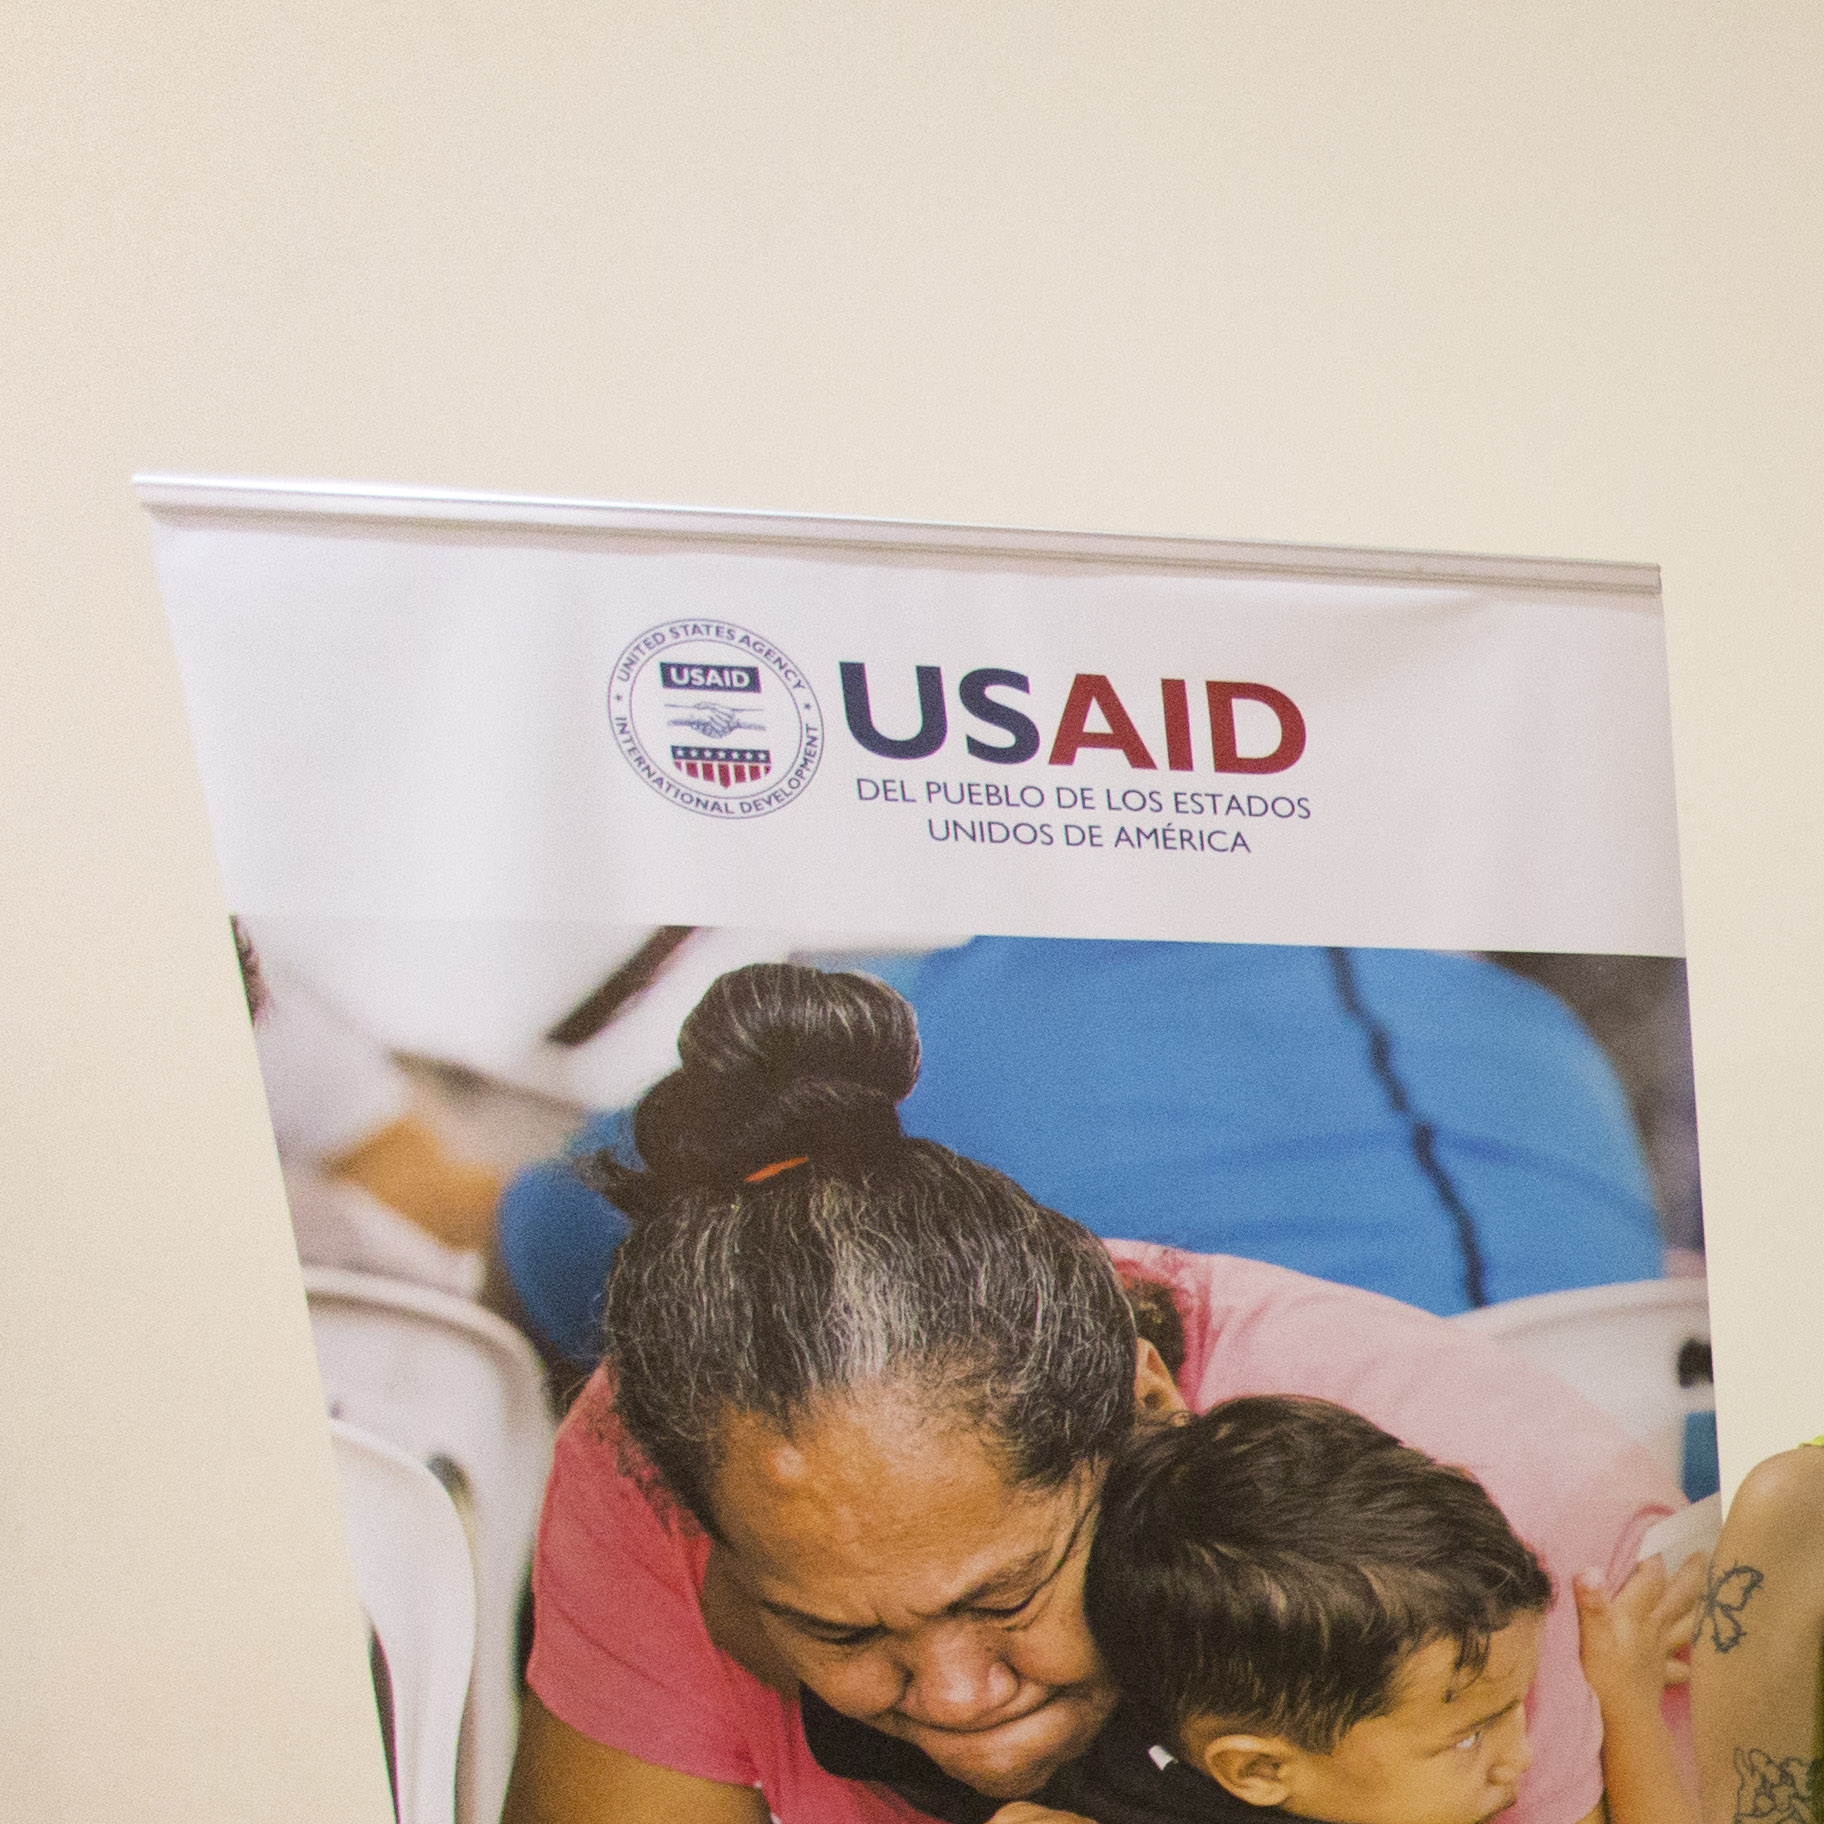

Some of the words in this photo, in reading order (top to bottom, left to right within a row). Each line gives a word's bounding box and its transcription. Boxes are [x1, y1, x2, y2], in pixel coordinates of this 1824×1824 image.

[617, 632, 666, 682] UNITED
[669, 623, 736, 641] STATES
[739, 634, 806, 690] AGENCY
[670, 666, 751, 688] USAID
[838, 661, 1308, 775] USAID
[615, 716, 735, 814] INTERNATIONAL
[740, 723, 818, 814] DEVELOPMENT
[856, 778, 916, 804] DEL
[925, 780, 1045, 810] PUEBLO
[1056, 786, 1096, 811] DE
[1105, 788, 1164, 815] LOS
[1174, 790, 1312, 820] ESTADOS
[927, 818, 1055, 848] UNIDOS
[1065, 823, 1104, 849] DE
[1114, 822, 1252, 854] AMÉRICA
